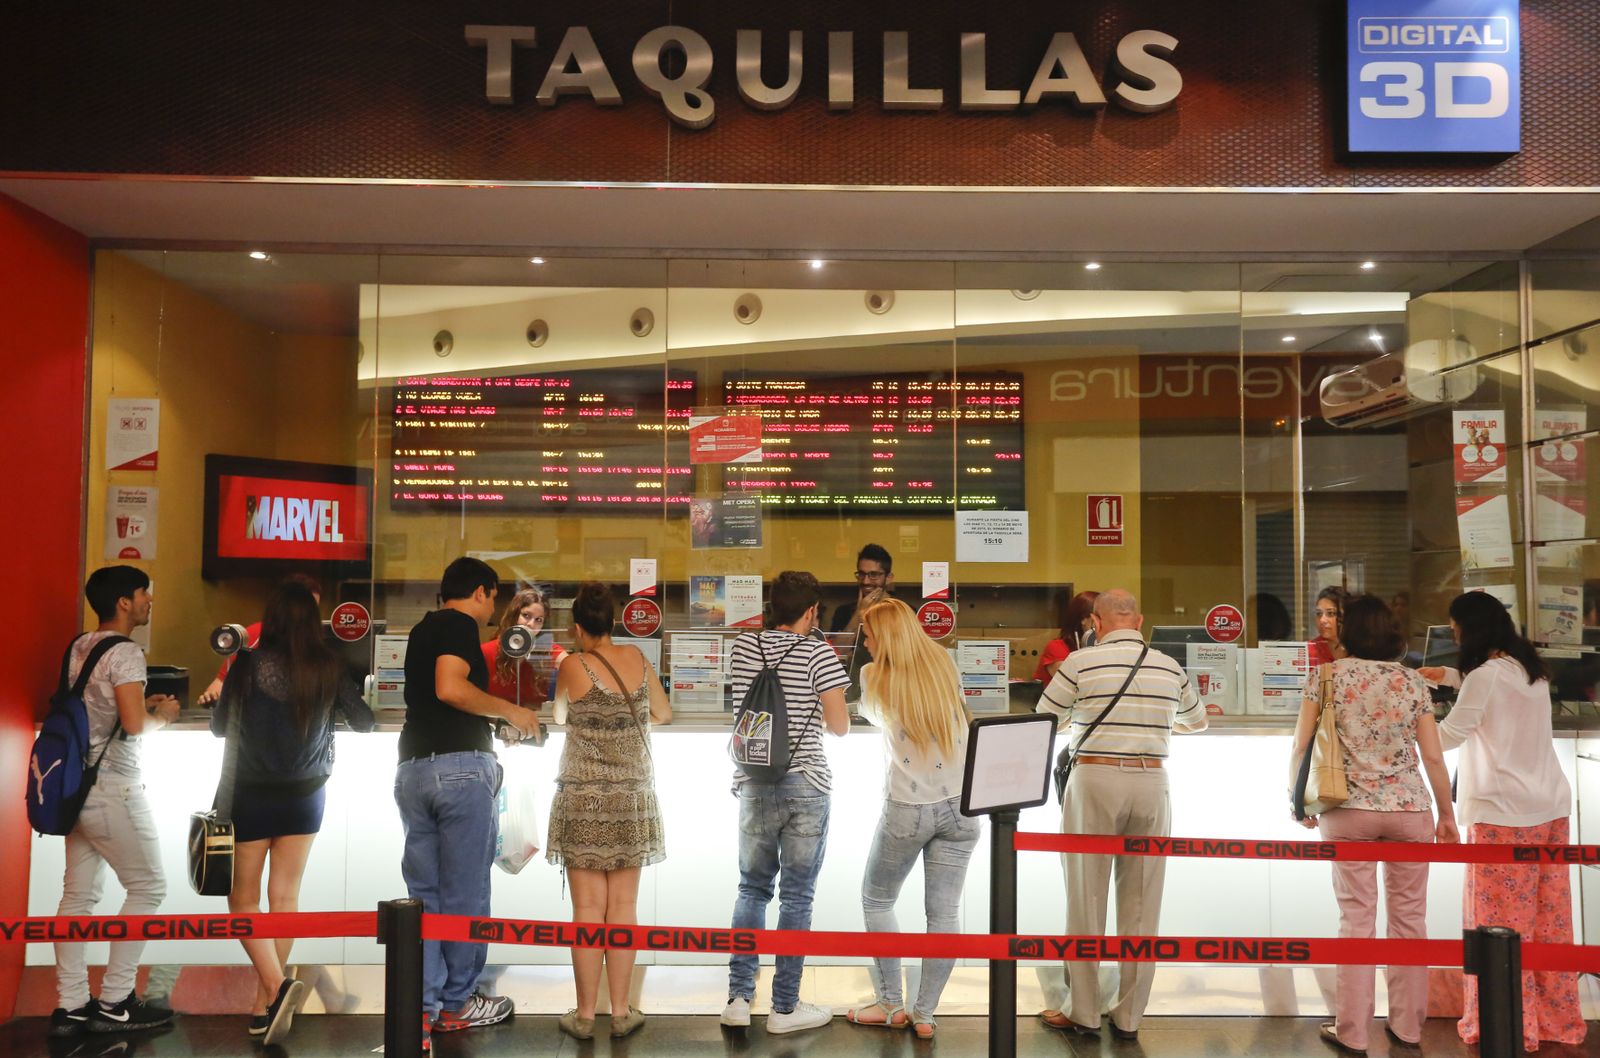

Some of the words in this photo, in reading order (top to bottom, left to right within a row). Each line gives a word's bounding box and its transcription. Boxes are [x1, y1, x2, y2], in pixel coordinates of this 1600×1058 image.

[1364, 25, 1504, 45] DIGITAL
[464, 25, 1184, 129] TAQUILLAS
[1360, 61, 1509, 119] 3D
[1461, 420, 1497, 429] FAMILIA
[246, 495, 343, 543] MARVEL
[340, 614, 354, 624] 3D
[631, 610, 646, 620] 3D
[924, 612, 940, 622] 3D
[1214, 616, 1228, 626] 3D
[1211, 682, 1222, 692] 1€
[1153, 839, 1244, 856] YELMO
[1255, 842, 1336, 858] CINES
[1544, 848, 1600, 862] YEL
[0, 920, 128, 940] YELMO
[142, 918, 253, 938] CINES
[509, 924, 633, 948] YELMO
[647, 930, 756, 951] CINES
[1050, 939, 1180, 960] YELMO
[1195, 941, 1310, 960] CINES
